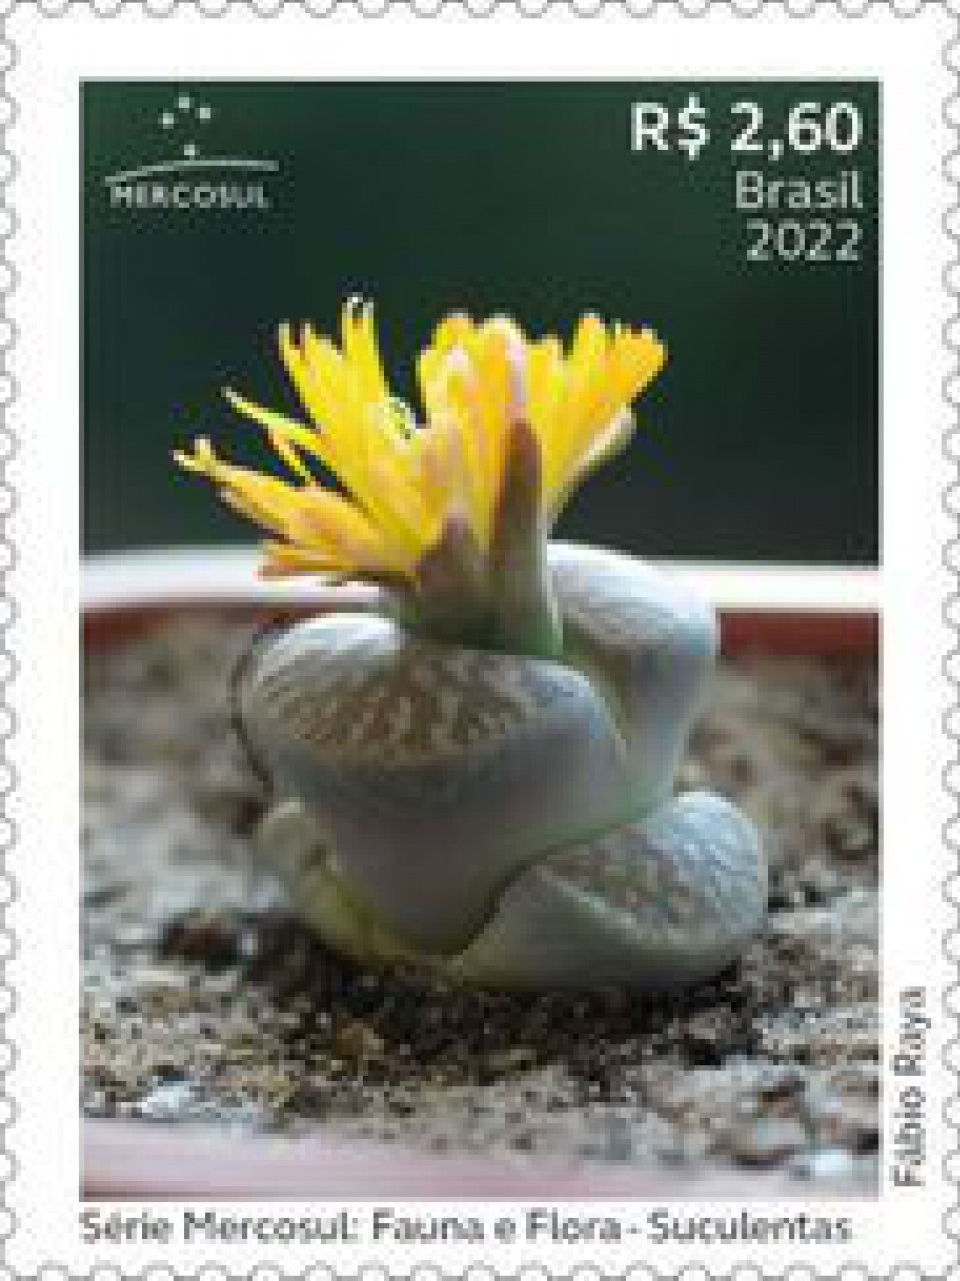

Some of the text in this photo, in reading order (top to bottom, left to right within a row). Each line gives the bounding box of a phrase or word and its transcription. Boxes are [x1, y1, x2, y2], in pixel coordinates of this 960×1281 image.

[630, 95, 863, 162] R$ 2,60
[108, 182, 270, 210] MERCOSUL
[735, 170, 864, 211] Brasil
[746, 222, 863, 262] 2022
[893, 987, 934, 1186] Fábio Raya
[79, 1211, 172, 1243] Série
[183, 1211, 358, 1243] Mercosul:
[372, 1211, 484, 1243] Fauna
[494, 1219, 516, 1243] e
[526, 1211, 620, 1243] Flora
[648, 1211, 852, 1243] Suculentas
